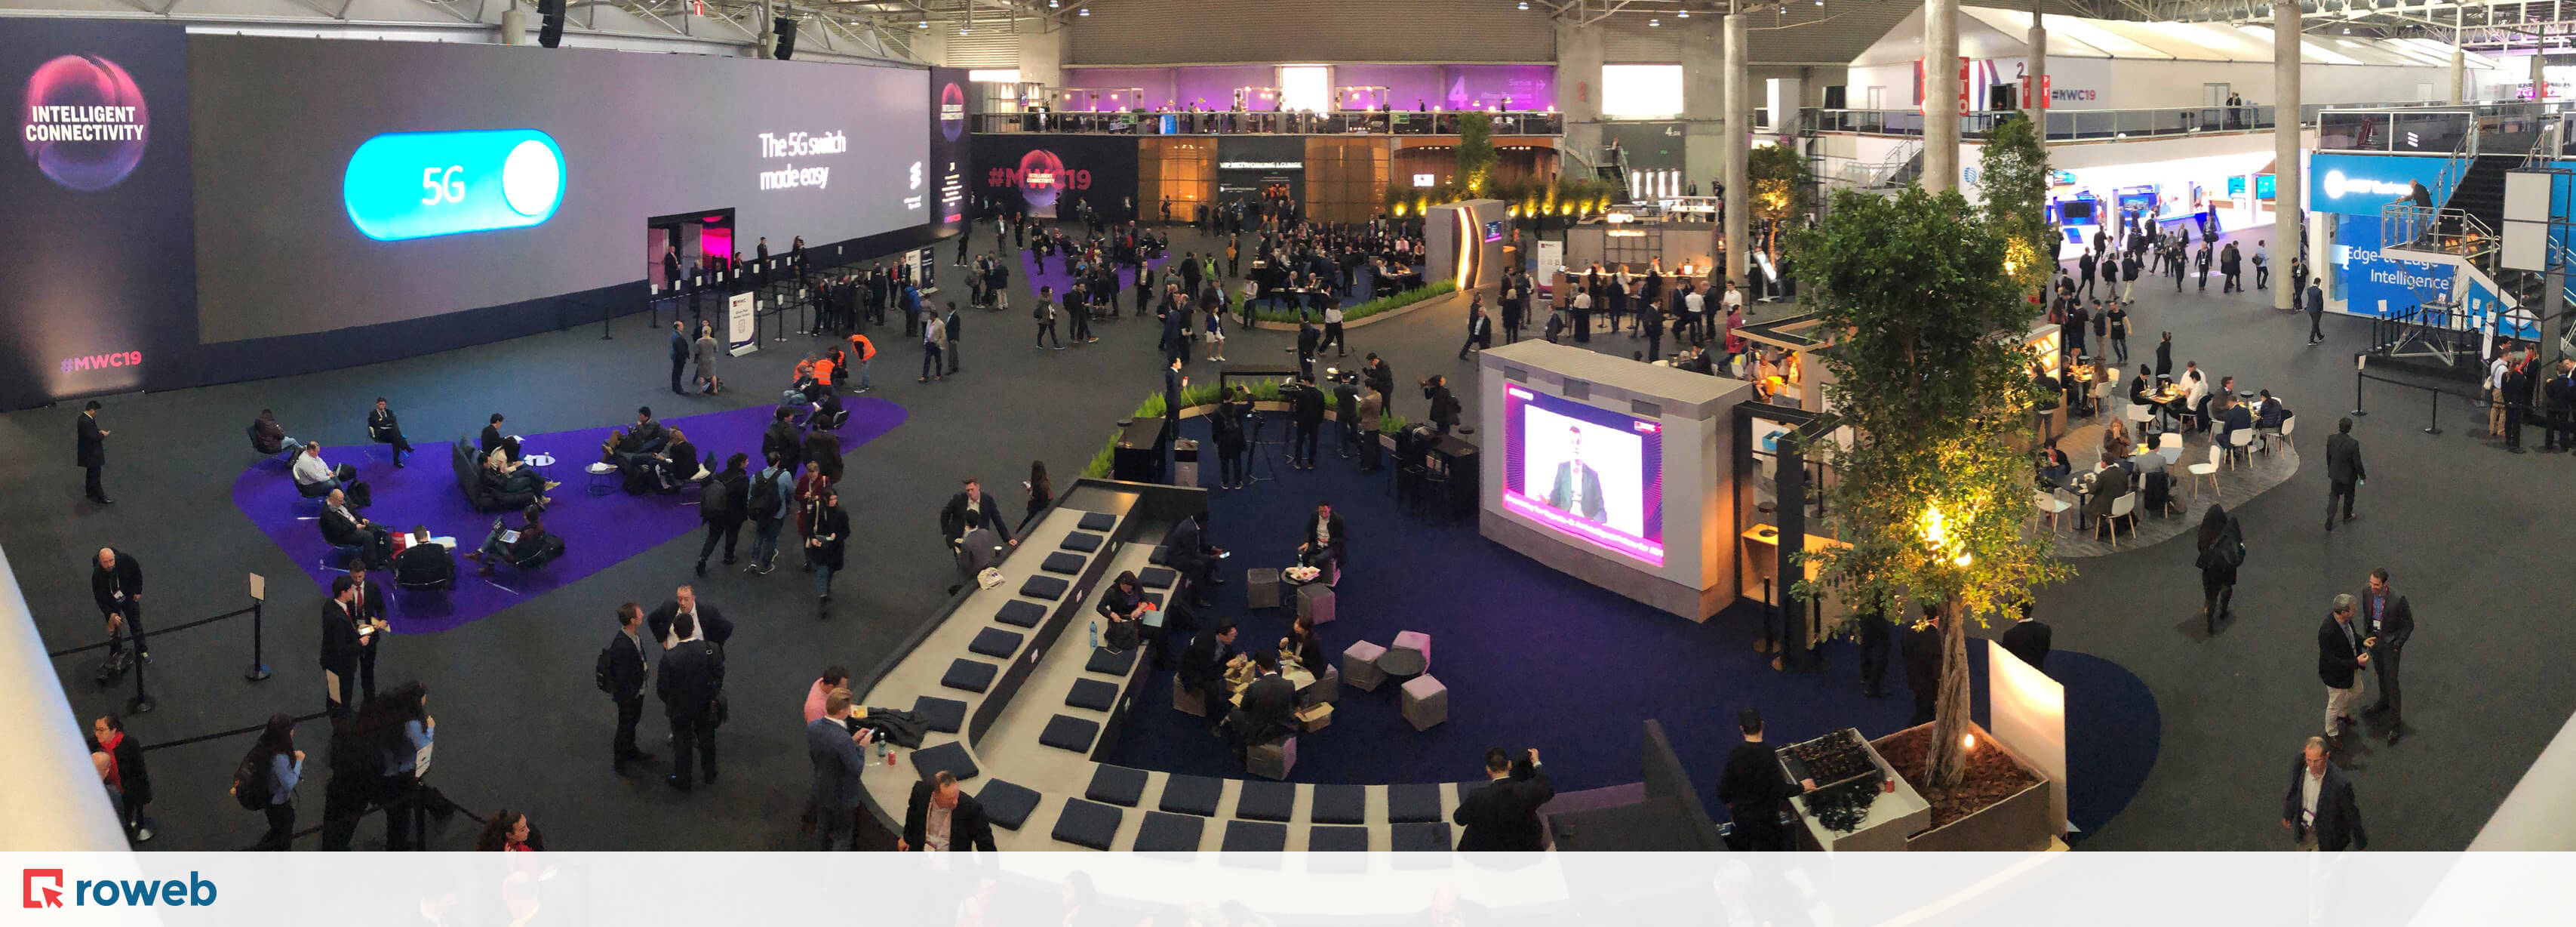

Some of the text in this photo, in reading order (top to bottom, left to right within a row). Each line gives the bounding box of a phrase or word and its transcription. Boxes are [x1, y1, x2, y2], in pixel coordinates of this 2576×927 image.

[2016, 61, 2024, 79] 2
[1449, 75, 1468, 108] 4
[32, 105, 136, 122] INTELLIGENT
[26, 124, 144, 141] CONNECTIVITY
[758, 130, 847, 158] The 5G switch
[422, 165, 466, 205] 5G
[760, 163, 829, 190] made easy
[988, 168, 1092, 190] #MWC19
[2370, 269, 2449, 290] Intelligence
[60, 350, 142, 372] #MWC19
